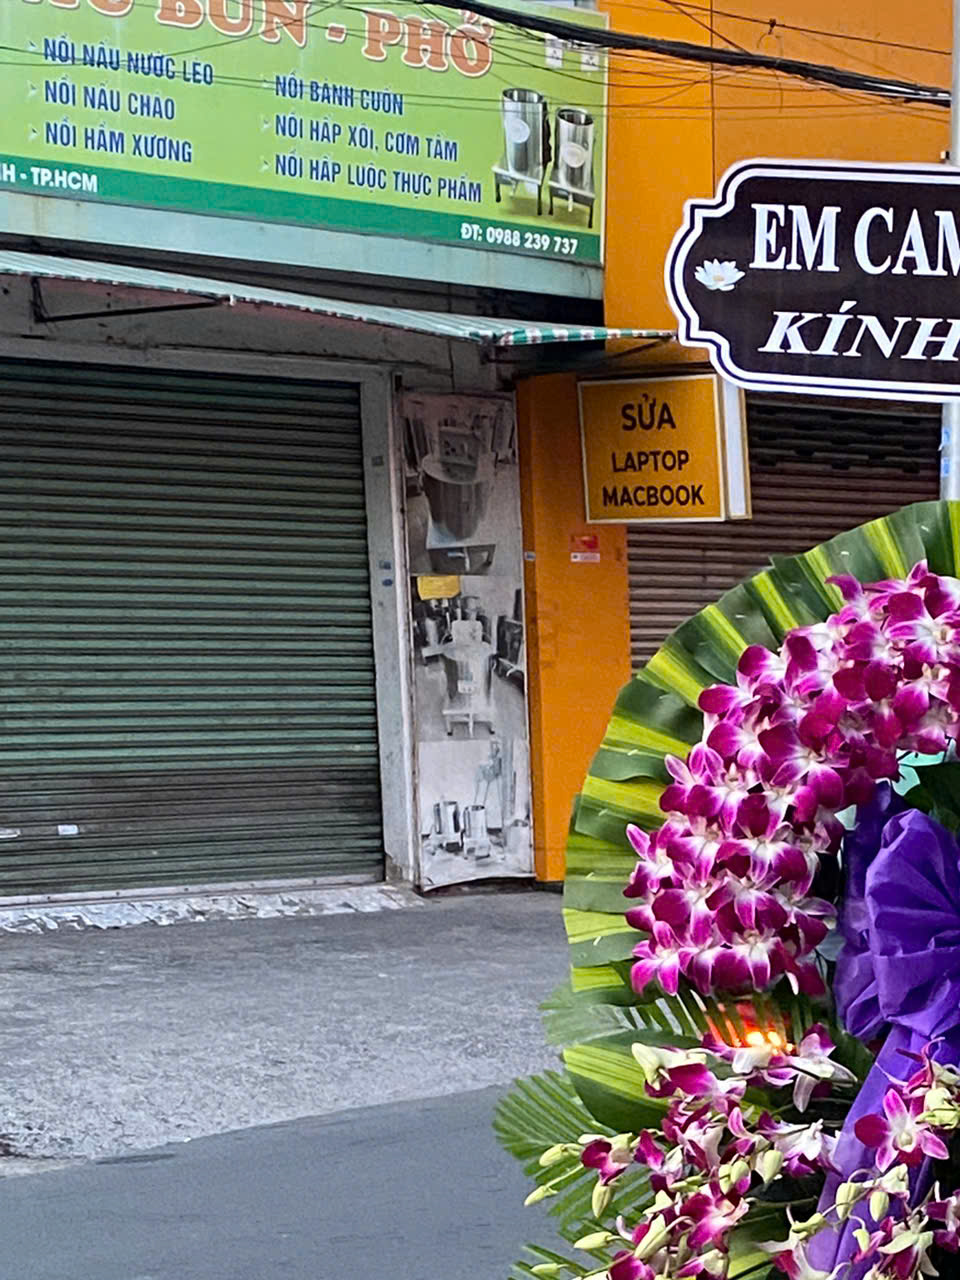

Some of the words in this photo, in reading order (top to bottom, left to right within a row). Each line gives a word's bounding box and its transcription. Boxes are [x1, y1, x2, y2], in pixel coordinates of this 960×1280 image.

[361, 8, 494, 78] PHỞ
[132, 133, 193, 163] XƯƠNG
[385, 131, 420, 157] CƠM
[30, 166, 99, 193] TP.HCM
[460, 222, 483, 241] ĐT:
[486, 226, 521, 247] 0988
[523, 232, 551, 251] 239
[553, 236, 578, 254] 737
[749, 203, 841, 272] EM
[620, 394, 677, 431] SỬA
[611, 450, 689, 473] LAPTOP
[602, 484, 705, 507] MACBOOK
